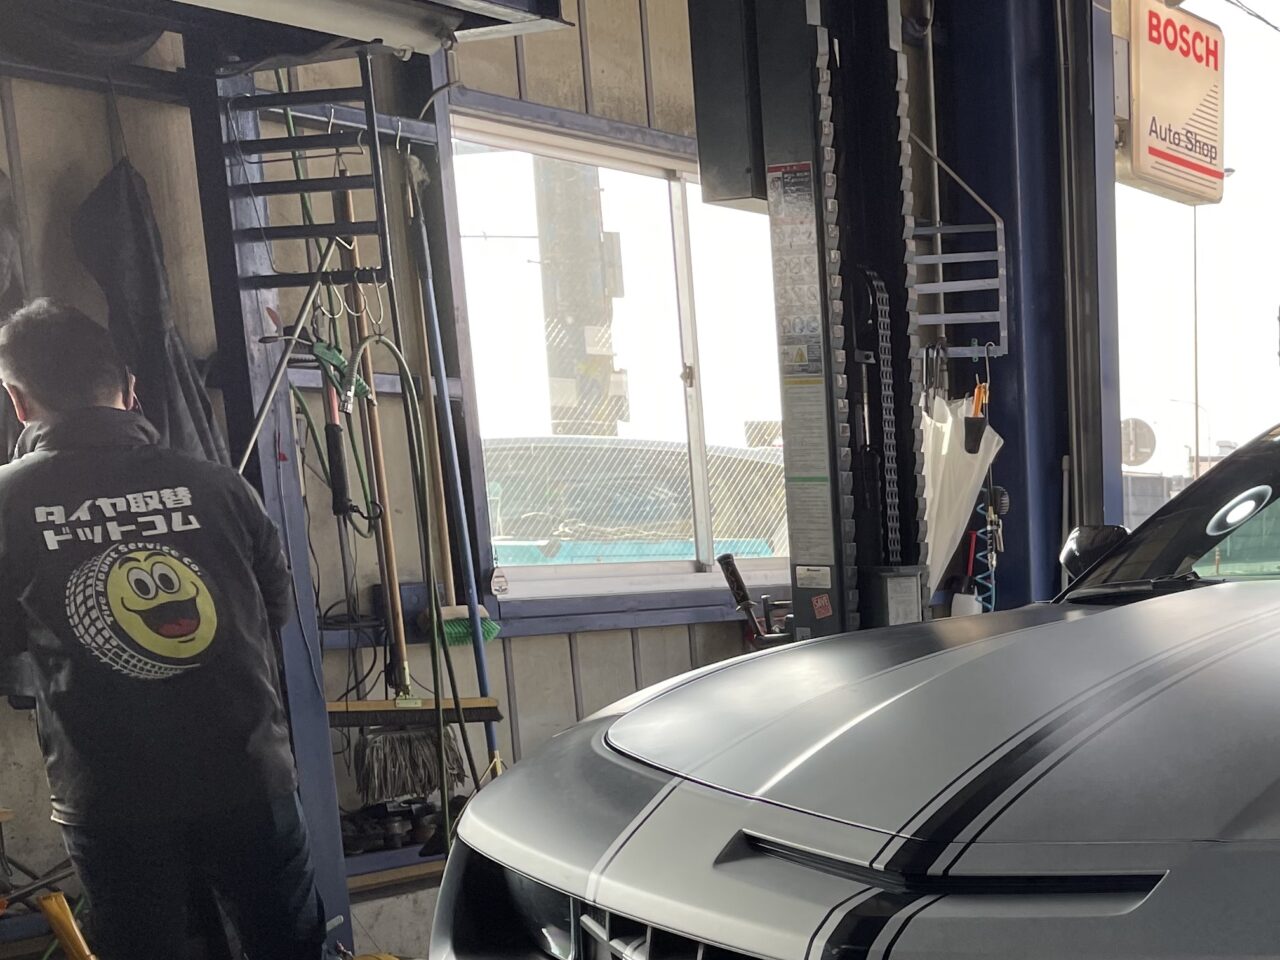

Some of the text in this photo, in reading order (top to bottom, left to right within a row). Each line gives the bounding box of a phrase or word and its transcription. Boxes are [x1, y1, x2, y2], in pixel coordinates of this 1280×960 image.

[1148, 10, 1218, 71] BOSCH
[1149, 116, 1217, 163] Auto Shop
[34, 486, 193, 525] タイヤ取替
[43, 511, 201, 550] ドットコム
[99, 596, 114, 625] Tire
[118, 542, 179, 557] Service
